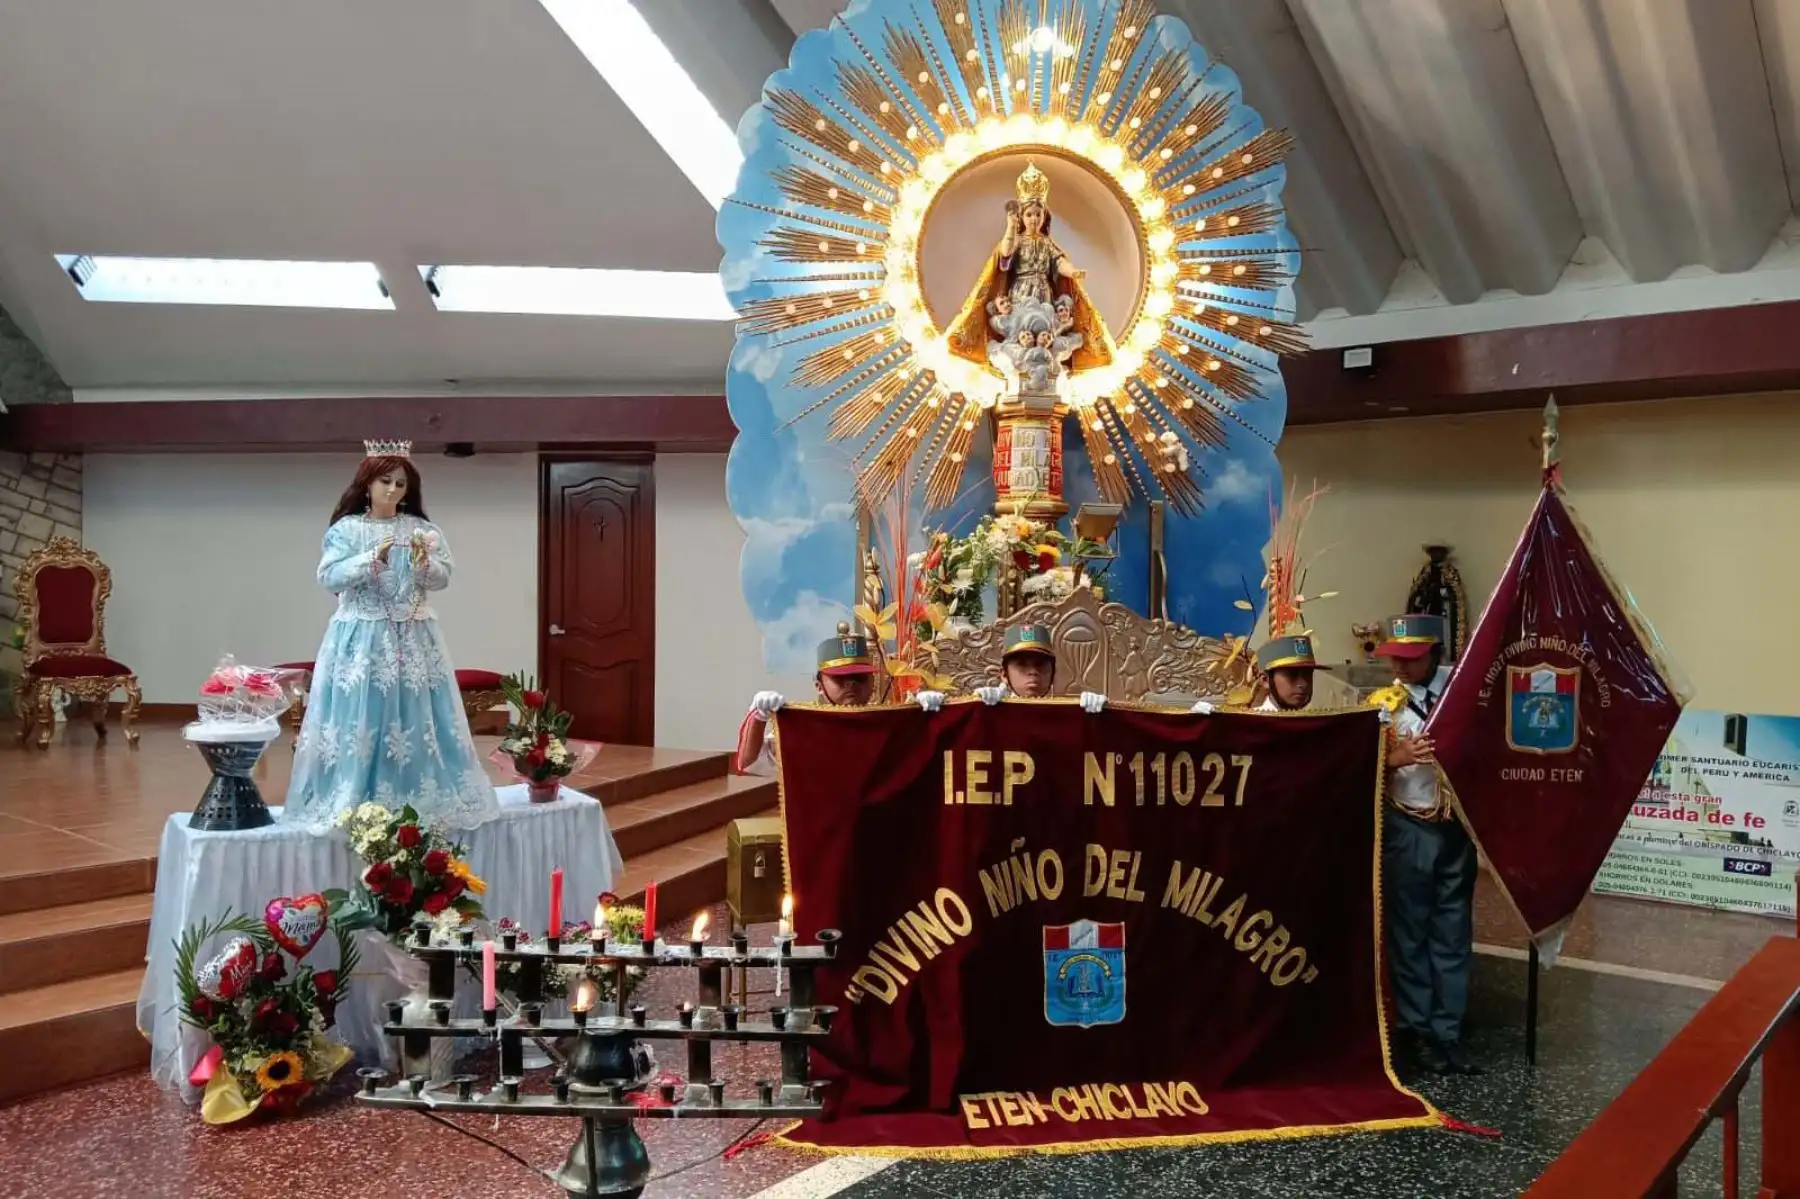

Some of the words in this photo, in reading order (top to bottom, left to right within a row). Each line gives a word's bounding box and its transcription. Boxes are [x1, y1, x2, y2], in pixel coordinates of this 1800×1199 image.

[1505, 638, 1537, 660] DIVINO
[1540, 632, 1566, 650] NIÑO
[1567, 643, 1587, 664] DEL
[1501, 768, 1545, 781] CIUDAD
[1551, 768, 1584, 783] ETEN
[1681, 766, 1698, 775] DEL
[1733, 770, 1740, 778] Y
[1663, 792, 1690, 802] esta
[1694, 795, 1722, 805] gran
[1632, 805, 1699, 822] uzada
[1708, 809, 1735, 826] de
[1743, 811, 1766, 829] fe
[1735, 861, 1761, 873] BCP
[978, 837, 1064, 918] NIÑO
[1083, 843, 1146, 902] DEL
